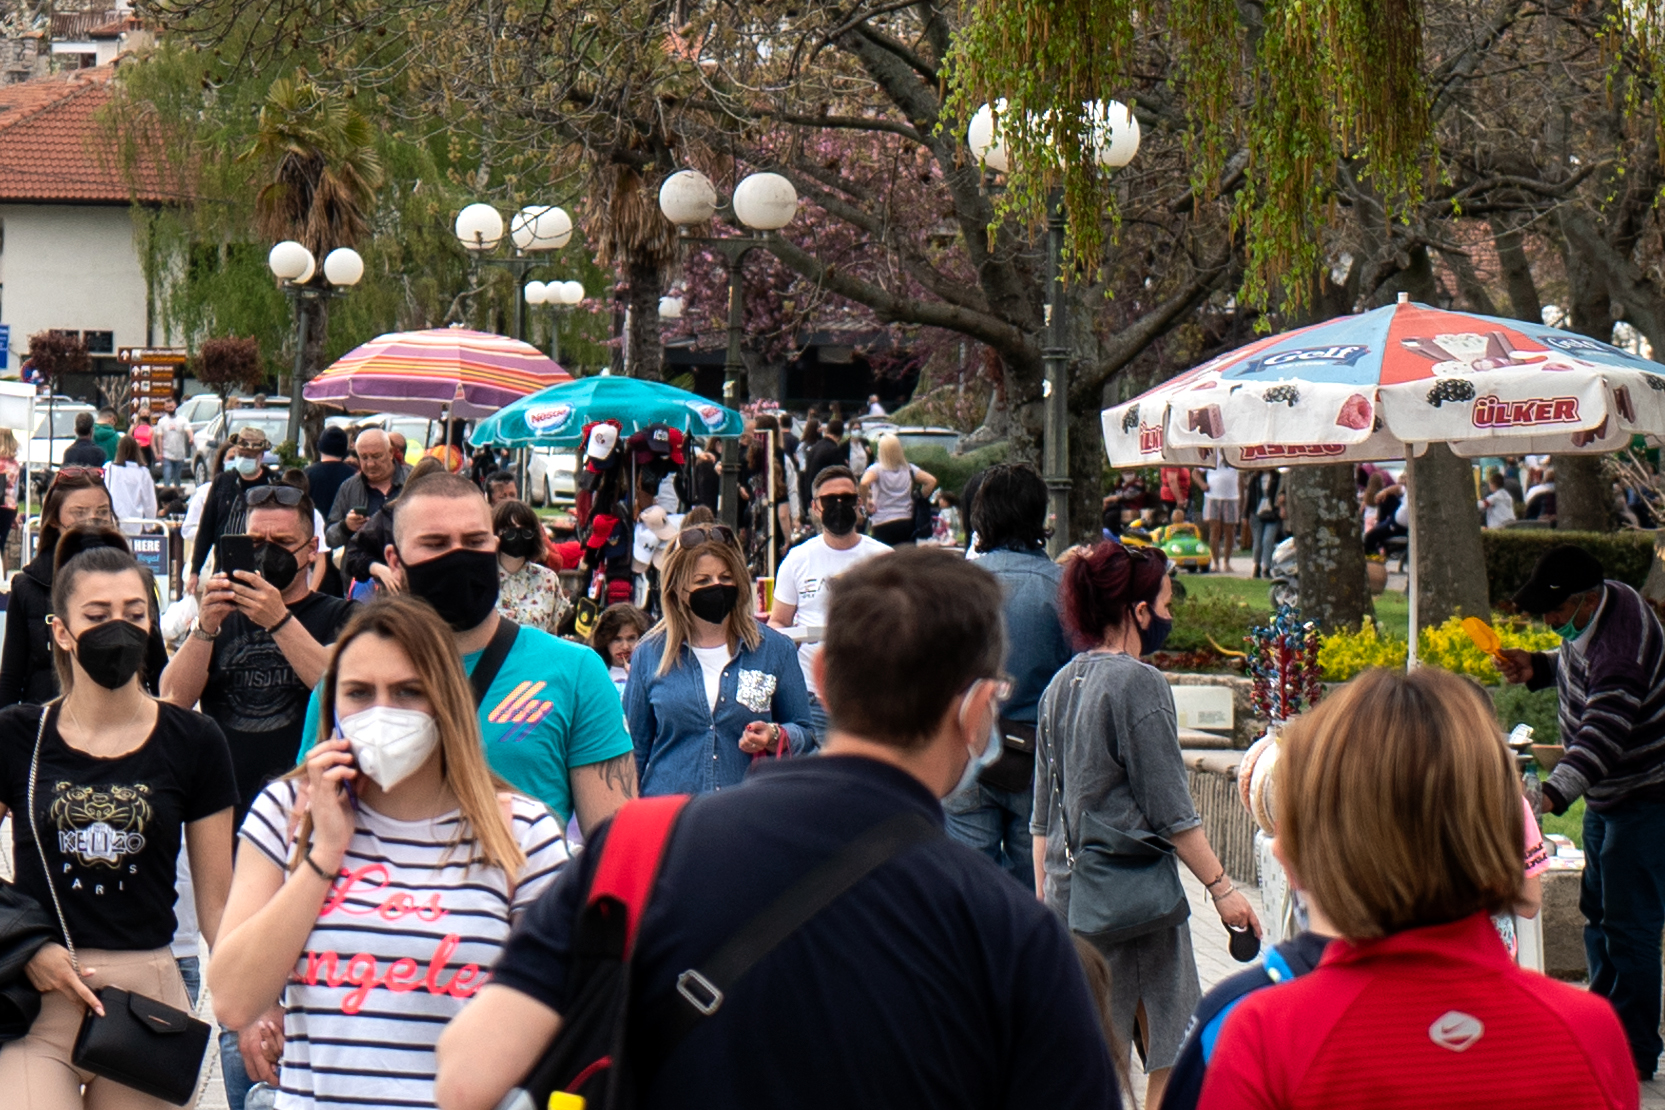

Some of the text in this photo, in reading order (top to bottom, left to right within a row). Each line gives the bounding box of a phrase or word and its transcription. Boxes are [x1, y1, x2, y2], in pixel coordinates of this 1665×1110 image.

[1263, 346, 1359, 365] Golf
[1472, 395, 1581, 428] ÜLKER
[134, 540, 161, 552] HERE
[58, 830, 146, 854] KENZO
[321, 863, 449, 922] Los
